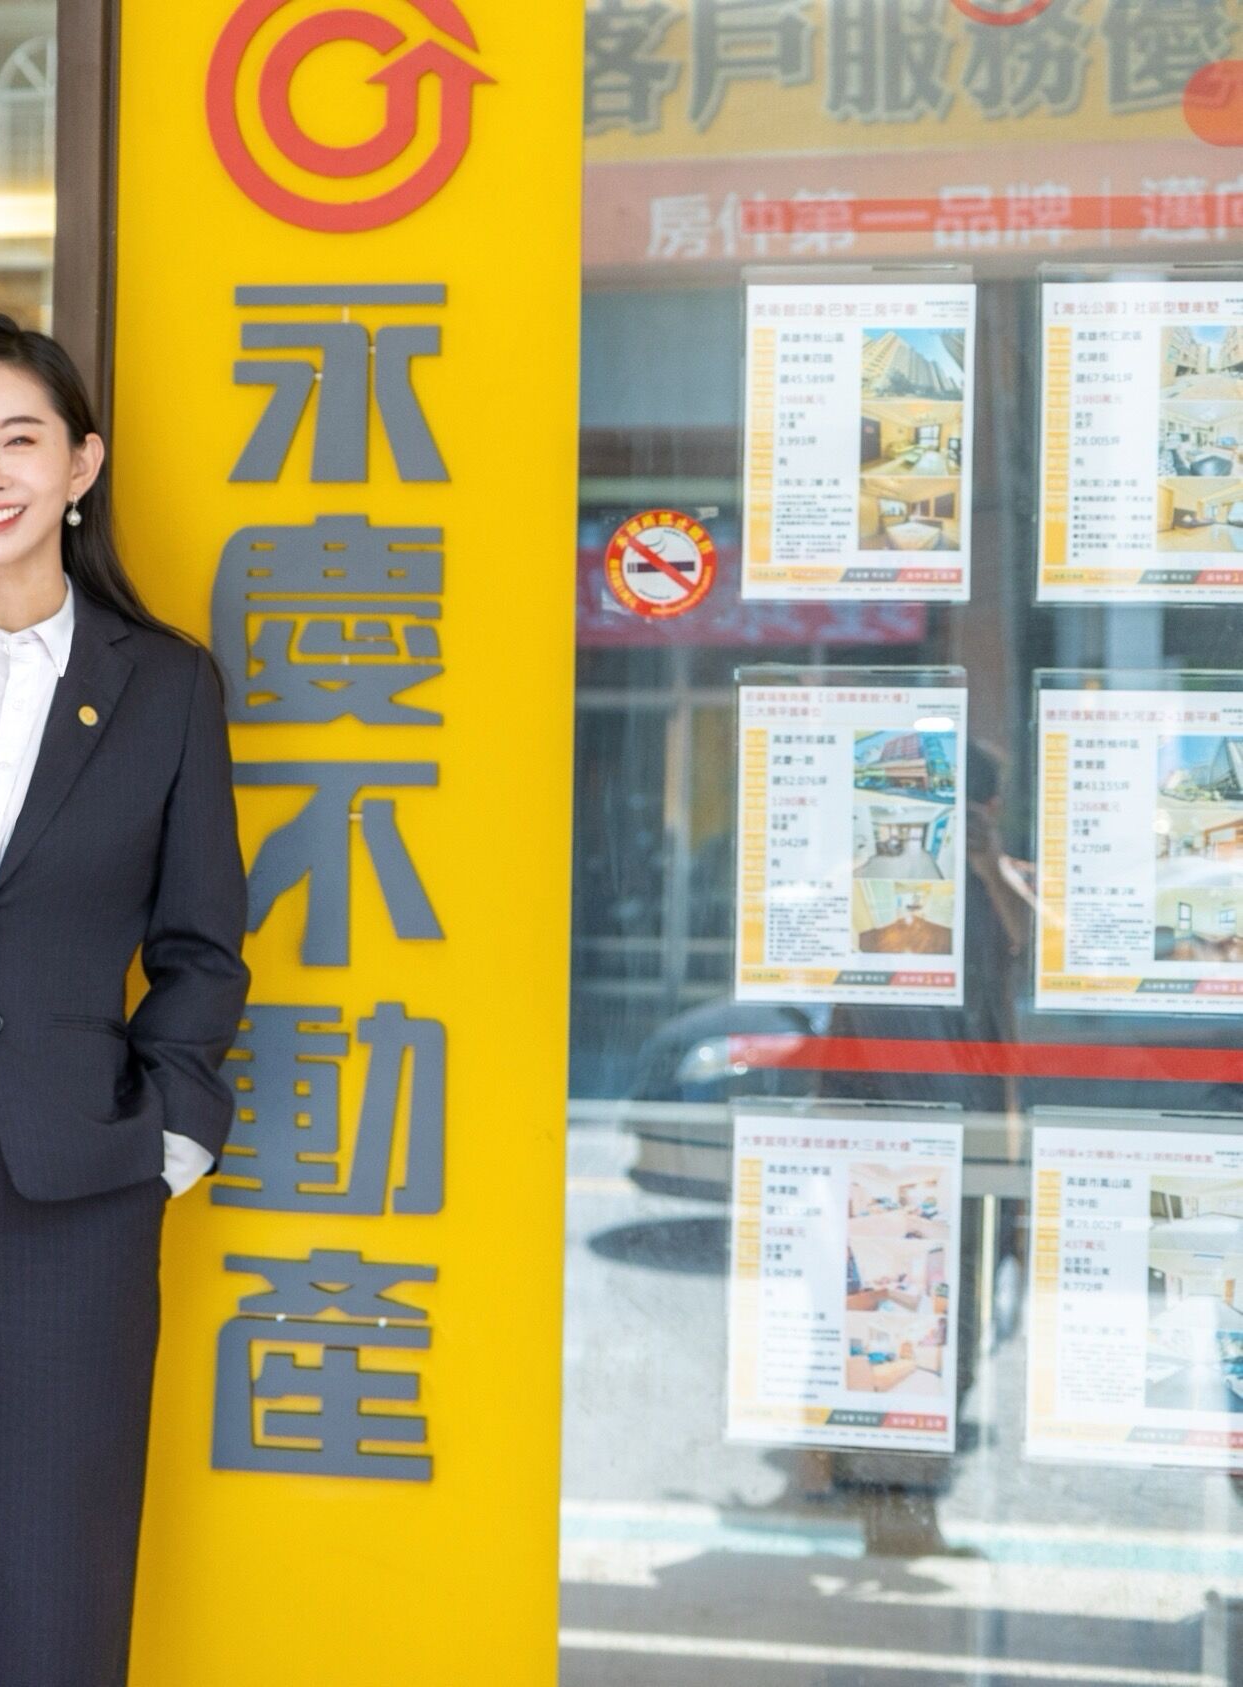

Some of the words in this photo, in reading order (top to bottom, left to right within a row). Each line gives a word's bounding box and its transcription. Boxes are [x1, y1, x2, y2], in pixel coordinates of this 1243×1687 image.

[210, 283, 451, 1483] 永慶不動產
